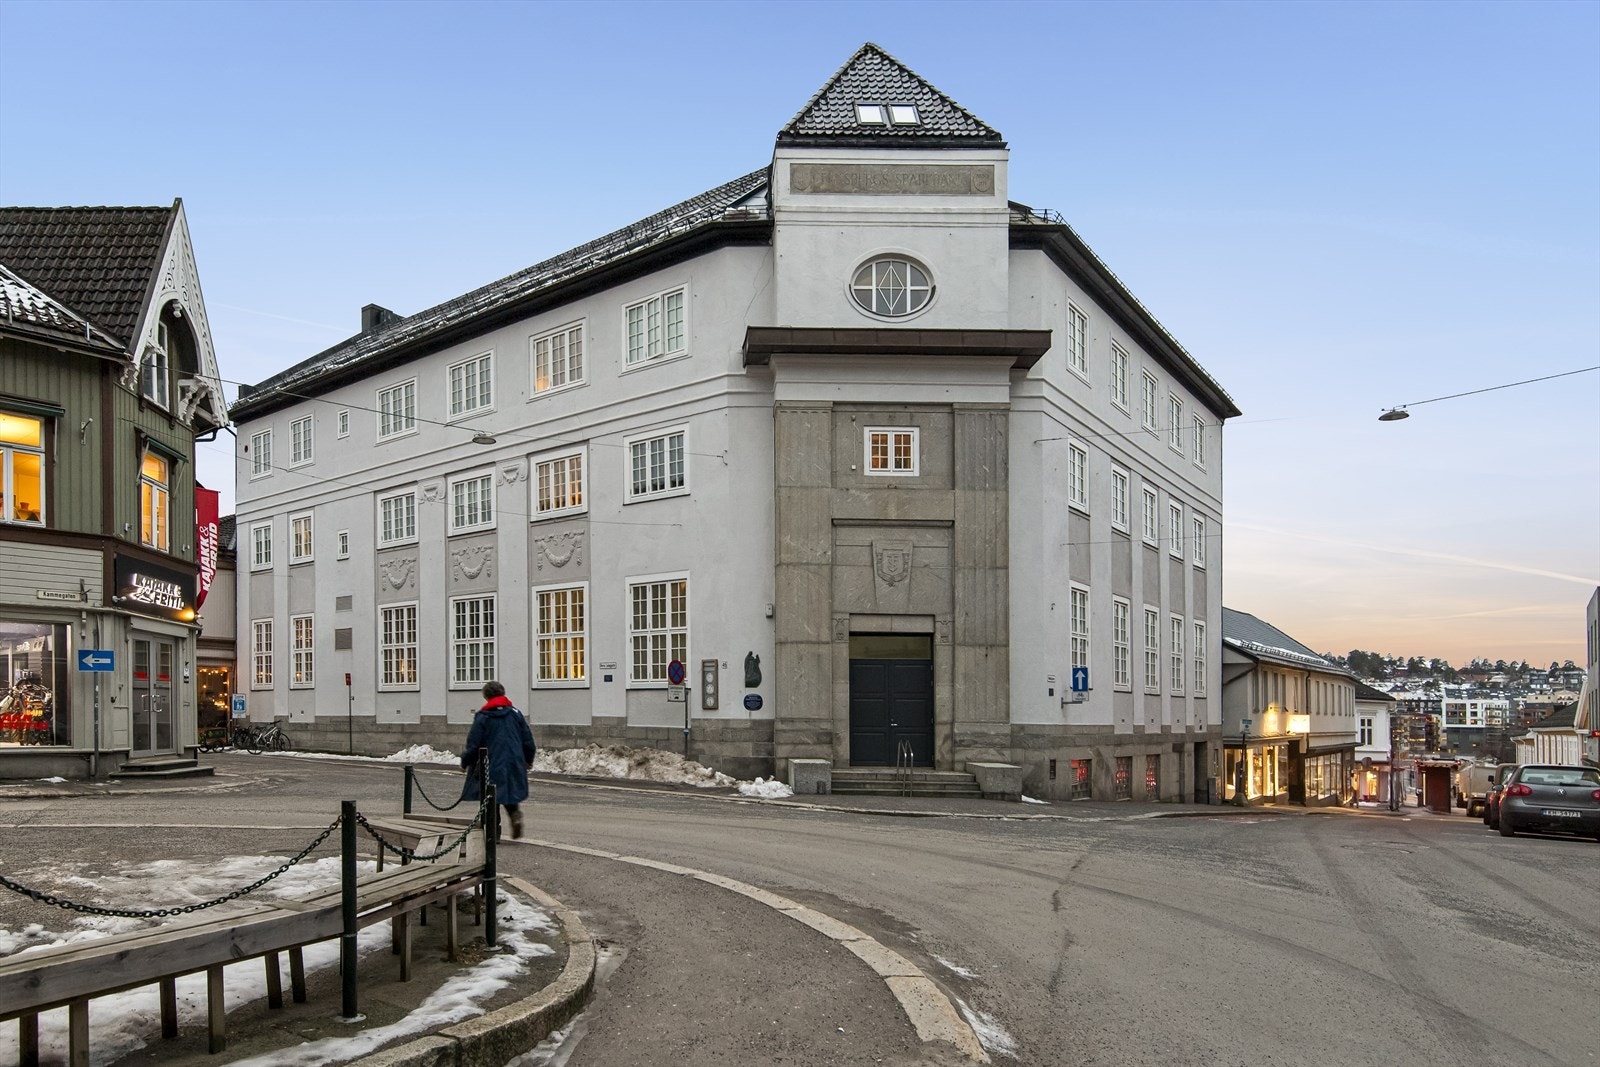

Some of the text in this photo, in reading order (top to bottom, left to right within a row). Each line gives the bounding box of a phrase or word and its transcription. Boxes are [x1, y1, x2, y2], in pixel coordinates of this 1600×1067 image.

[200, 535, 214, 592] KAJAKK
[208, 522, 218, 571] FRITID
[133, 573, 175, 595] KAJAKK
